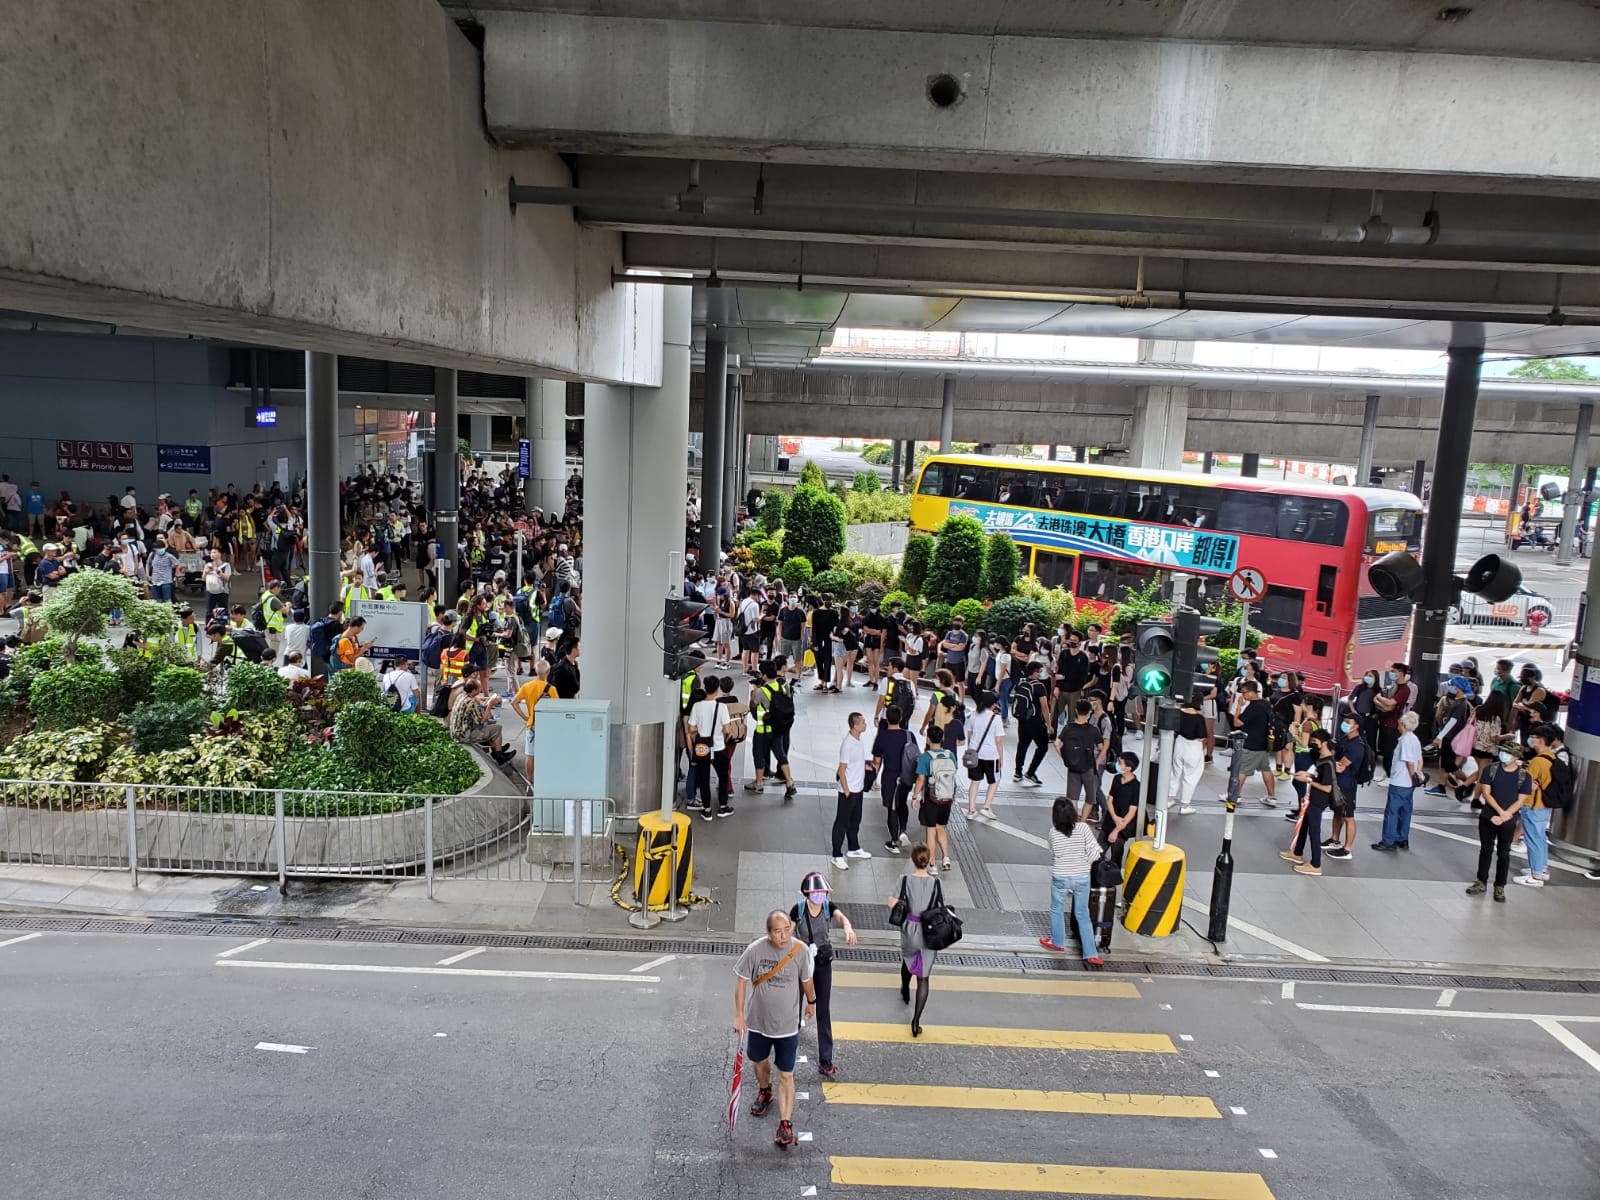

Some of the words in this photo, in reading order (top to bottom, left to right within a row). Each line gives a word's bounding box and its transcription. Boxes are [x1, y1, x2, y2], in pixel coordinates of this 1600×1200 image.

[59, 458, 89, 469] 優先座
[91, 463, 116, 471] Priority
